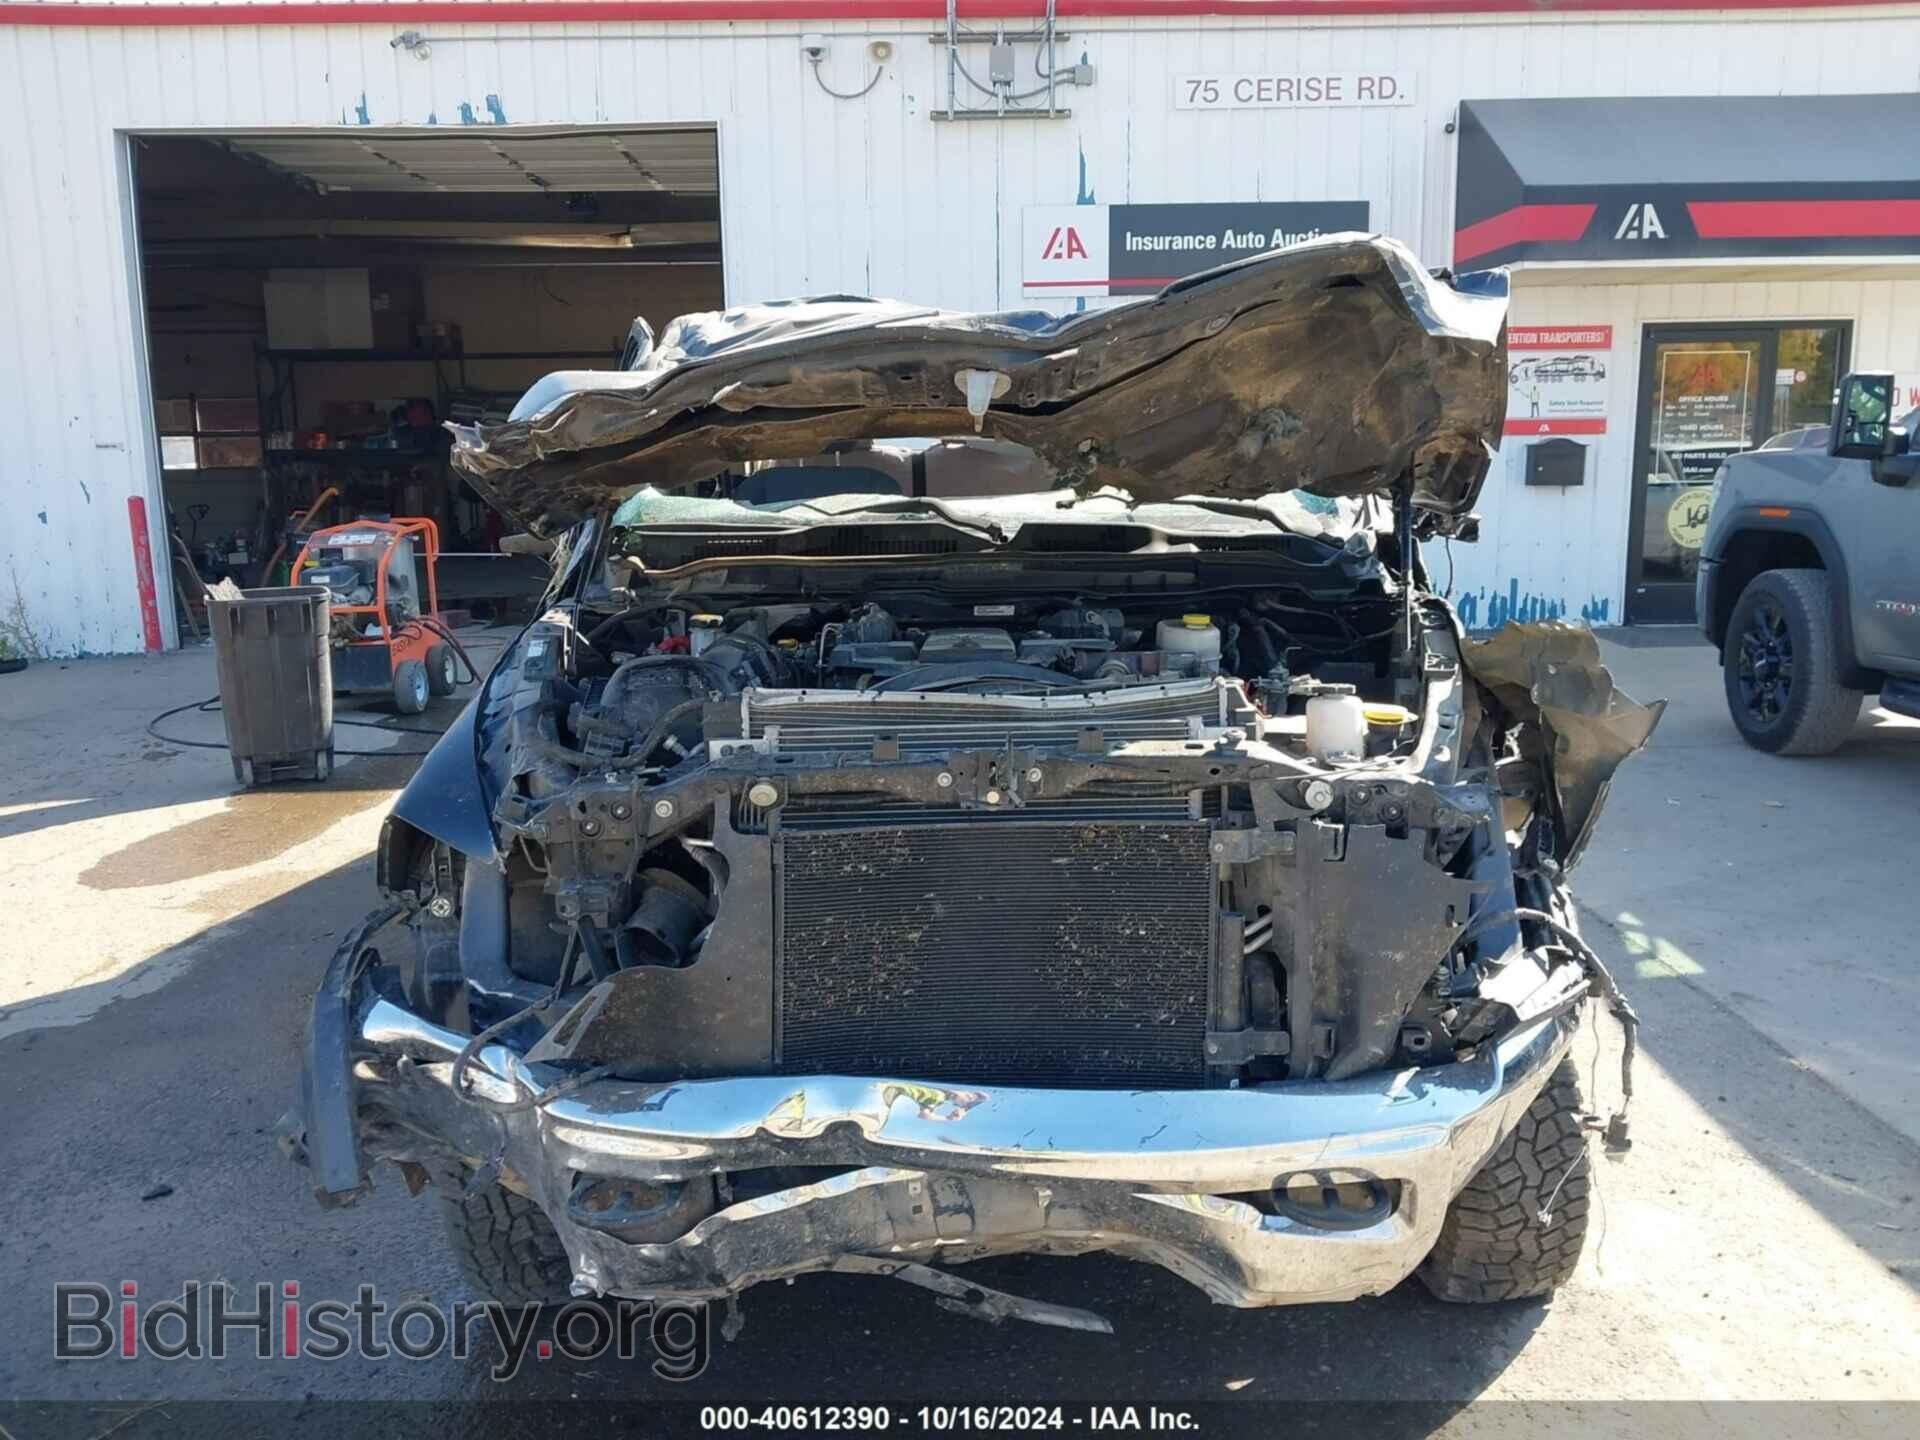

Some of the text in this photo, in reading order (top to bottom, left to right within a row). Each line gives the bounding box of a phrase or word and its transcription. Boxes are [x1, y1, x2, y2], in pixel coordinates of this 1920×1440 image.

[1185, 76, 1405, 103] 75 CERISE RD.
[1125, 231, 1217, 251] Insurance
[1222, 229, 1265, 249] Auto
